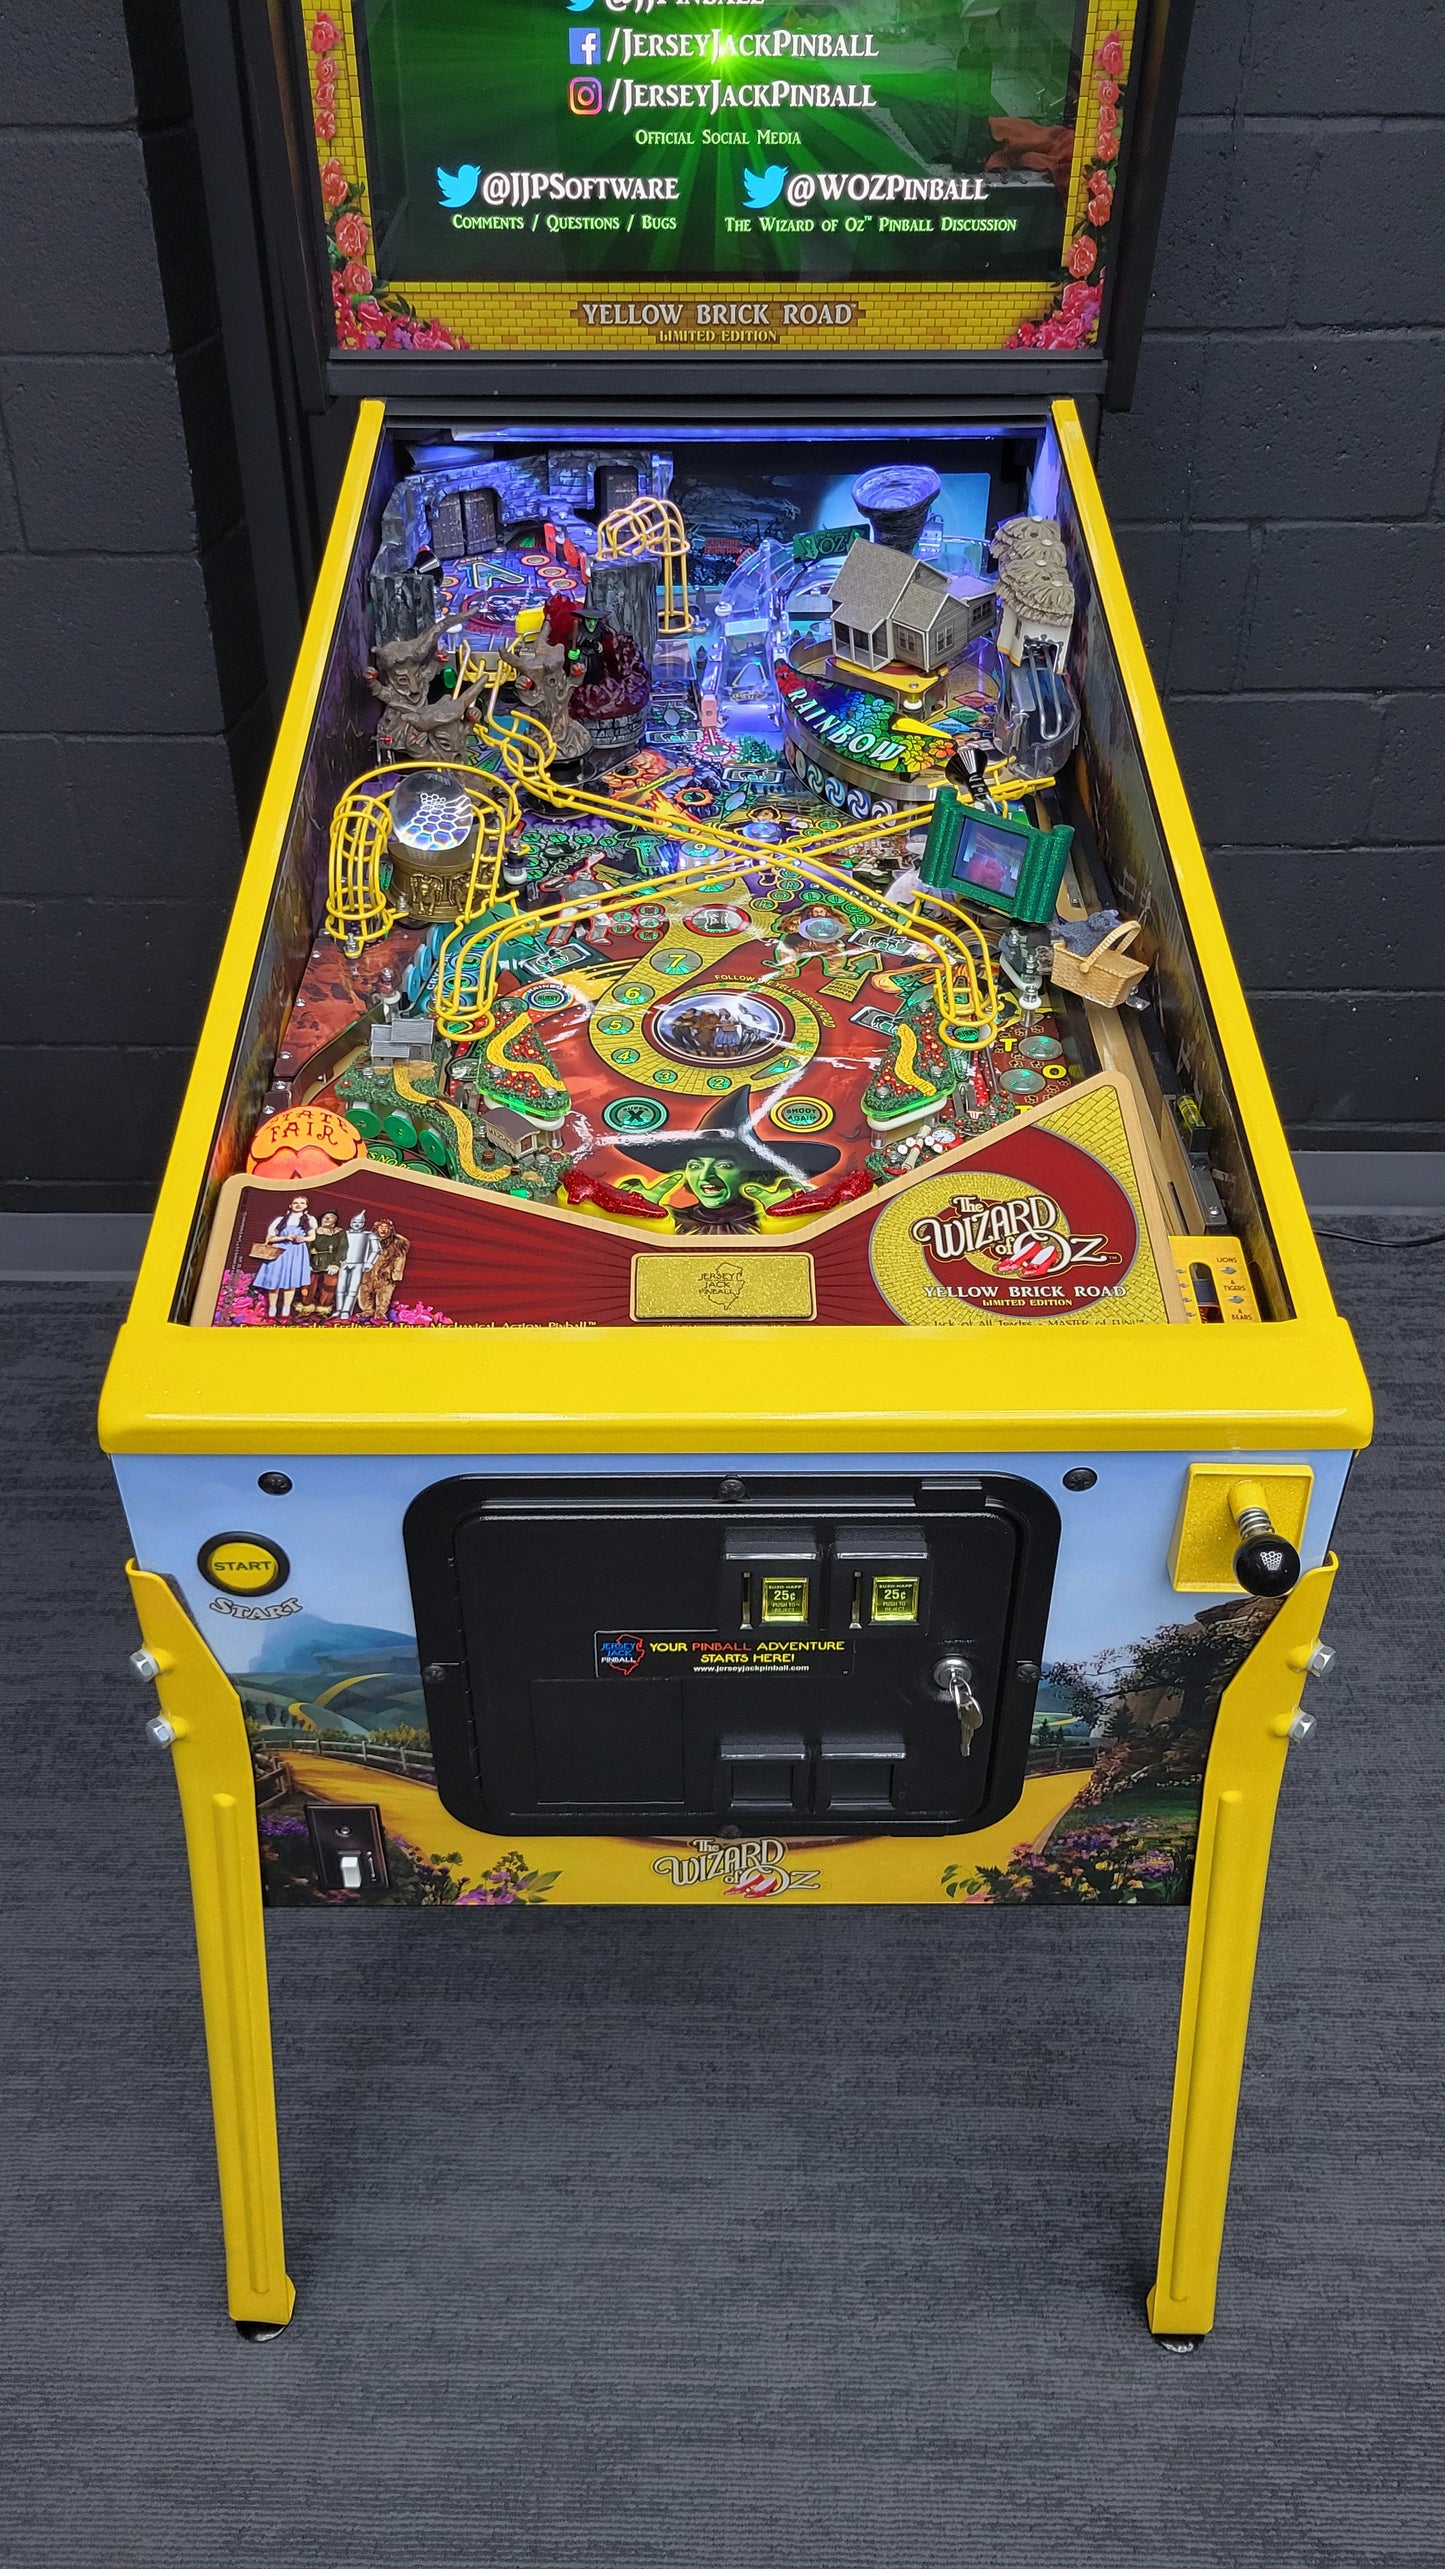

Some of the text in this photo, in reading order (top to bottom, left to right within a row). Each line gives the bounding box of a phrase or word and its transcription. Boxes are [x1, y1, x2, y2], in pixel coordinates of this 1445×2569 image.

[582, 304, 684, 326] YELLOW
[696, 304, 770, 325] BRICK
[659, 330, 777, 343] LIMITED EDITION
[787, 686, 908, 763] RAINBOW
[668, 954, 688, 967] 7
[626, 987, 641, 999] 6
[609, 1018, 623, 1030] 5
[618, 1051, 631, 1061] 4
[660, 1071, 671, 1082] 3
[714, 1077, 726, 1088] 2
[629, 1108, 645, 1123] X
[786, 1108, 817, 1116] SHOOT
[270, 1121, 338, 1146] FAIR
[954, 1196, 983, 1214] The
[914, 1196, 1056, 1258] WIZARD
[700, 1272, 734, 1281] JERSEY
[704, 1281, 731, 1289] JACK
[923, 1286, 1127, 1298] YELLOW BRICK ROAD
[982, 1299, 1072, 1307] LIMITED EDITION
[1231, 1313, 1253, 1321] BEARS
[214, 1561, 271, 1570] START
[773, 1590, 797, 1601] 25¢
[884, 1589, 907, 1600] 25¢
[601, 1642, 636, 1651] JERSEY
[650, 1641, 846, 1652] YOUR PINBALL ADVENTURE
[701, 1654, 795, 1663] STARTS HERE!
[693, 1664, 810, 1673] www.jerseyjackpinball.com
[692, 1839, 720, 1852] The
[653, 1839, 784, 1886] WIZARD
